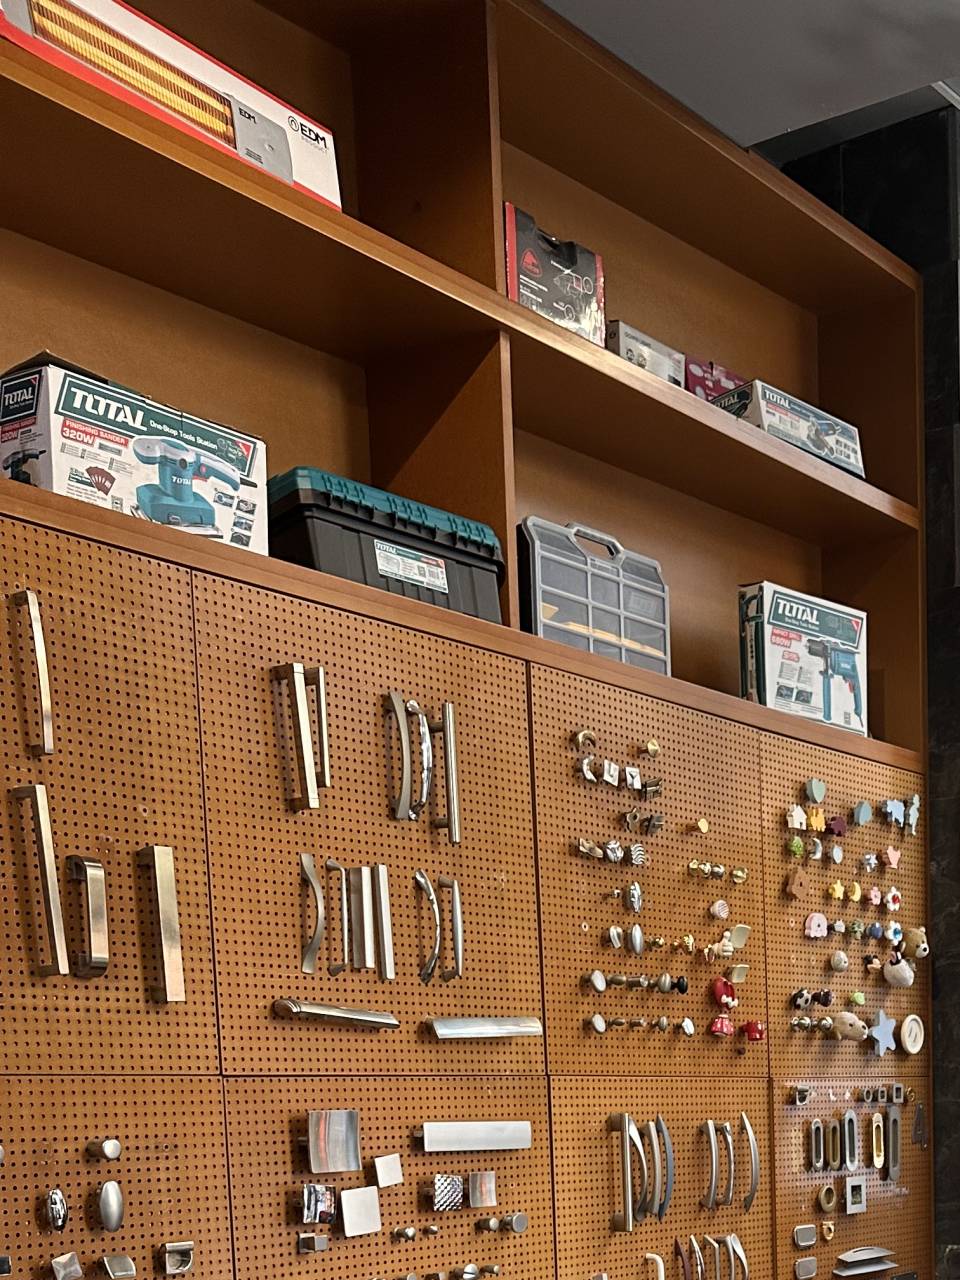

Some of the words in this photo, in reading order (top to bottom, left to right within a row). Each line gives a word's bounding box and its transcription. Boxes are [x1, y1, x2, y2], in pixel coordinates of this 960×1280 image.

[239, 107, 257, 124] EDM
[300, 122, 327, 148] EDM
[5, 387, 34, 406] TOTAL
[764, 389, 791, 409] TOTAL
[71, 387, 147, 431] TOTAL
[150, 420, 178, 436] One-Stop
[179, 430, 196, 442] Tools
[196, 436, 218, 450] Station
[62, 428, 95, 445] 320W
[66, 421, 99, 435] FINISHING
[100, 430, 126, 445] SANDER
[376, 542, 397, 554] TOTAL
[777, 599, 820, 625] TOTAL
